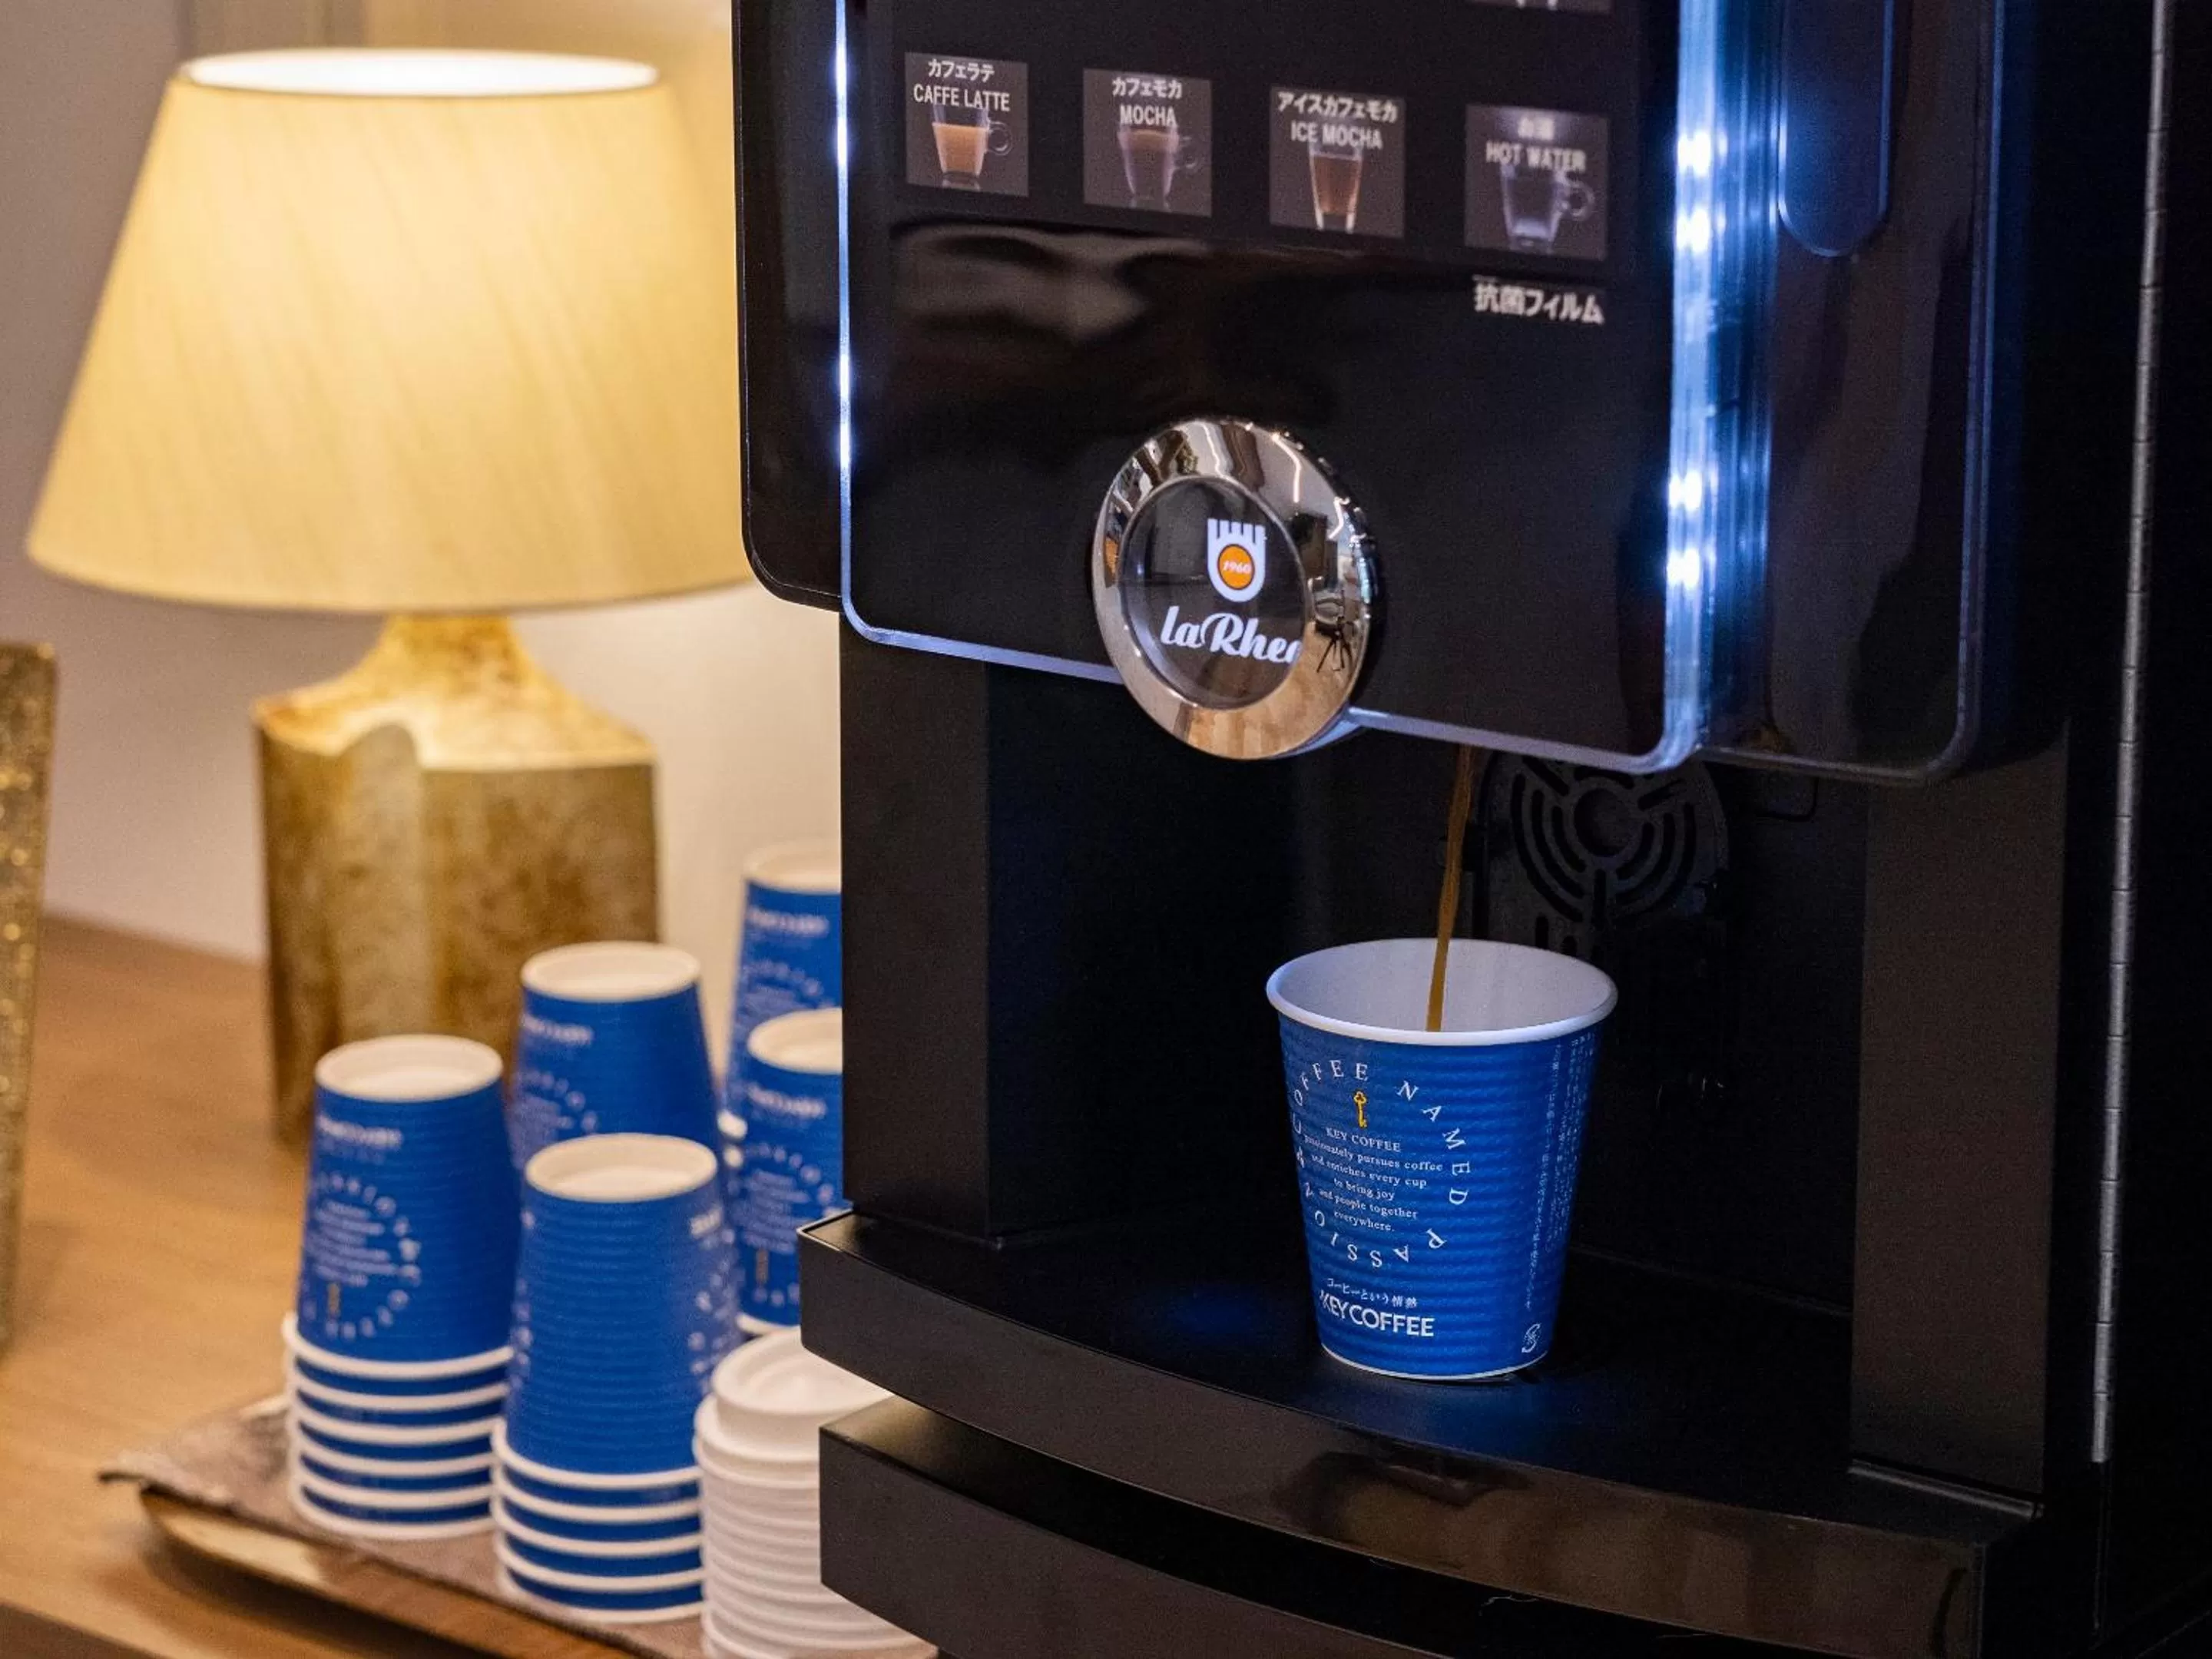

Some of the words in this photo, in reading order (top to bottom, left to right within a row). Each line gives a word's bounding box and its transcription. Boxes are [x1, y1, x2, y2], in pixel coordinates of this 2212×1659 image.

[928, 58, 995, 82] カフェラテ
[913, 84, 959, 107] CAFFE
[964, 88, 1010, 112] LATTE
[1112, 77, 1182, 100] カフェモカ
[1119, 104, 1177, 127] MOCHA
[1278, 91, 1398, 124] アイスカフェモカ
[1290, 120, 1318, 143] ICE
[1322, 123, 1382, 150] MOCHA
[1485, 141, 1522, 166] HOT
[1525, 146, 1587, 173] WATER
[1474, 283, 1604, 324] 抗菌フィルム
[1222, 561, 1252, 575] 1960
[1326, 1127, 1348, 1141] KEY
[1351, 1134, 1402, 1152] COFFEE
[1404, 1161, 1443, 1172] coffee
[1345, 1181, 1373, 1199] bring
[1376, 1190, 1396, 1201] joy
[1369, 1172, 1401, 1187] every
[1405, 1176, 1427, 1190] cup
[1333, 1195, 1366, 1210] people
[1369, 1205, 1419, 1220] together
